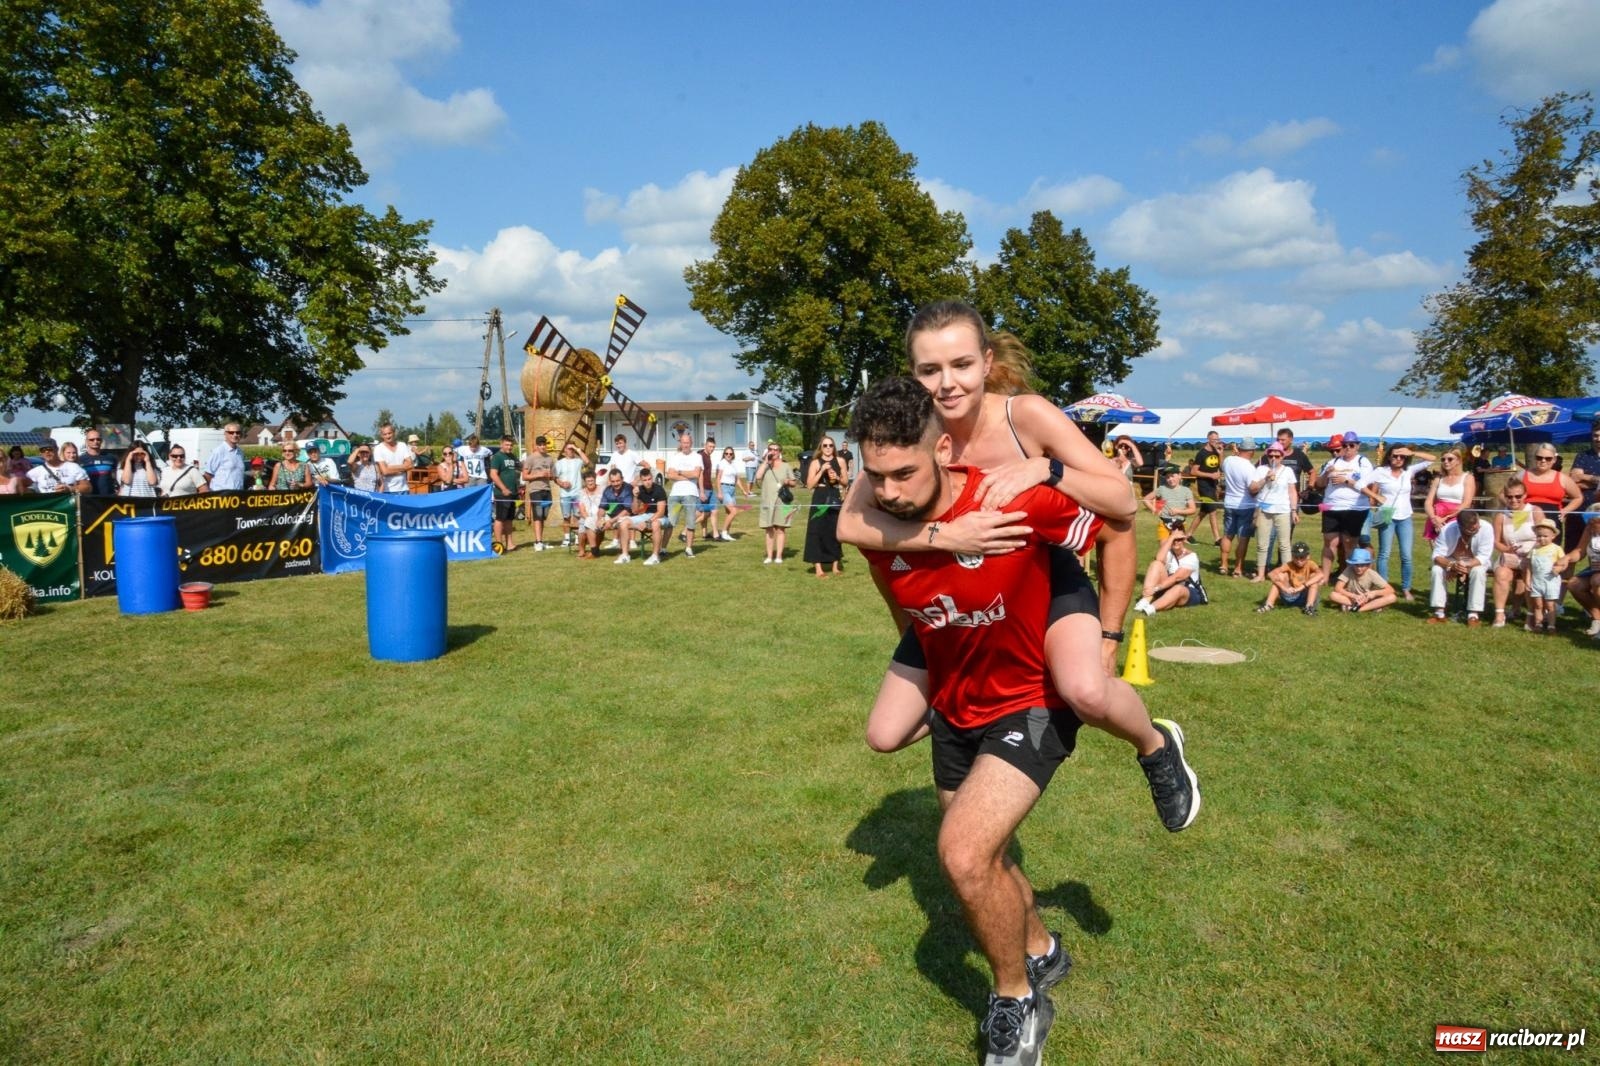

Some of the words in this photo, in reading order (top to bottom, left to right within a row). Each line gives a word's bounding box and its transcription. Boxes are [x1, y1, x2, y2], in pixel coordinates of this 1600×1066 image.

[467, 460, 482, 476] 94
[162, 496, 240, 511] DEKARSTWO
[387, 511, 460, 531] GMINA
[200, 545, 238, 566] 880
[241, 541, 276, 562] 667
[279, 537, 313, 558] 860
